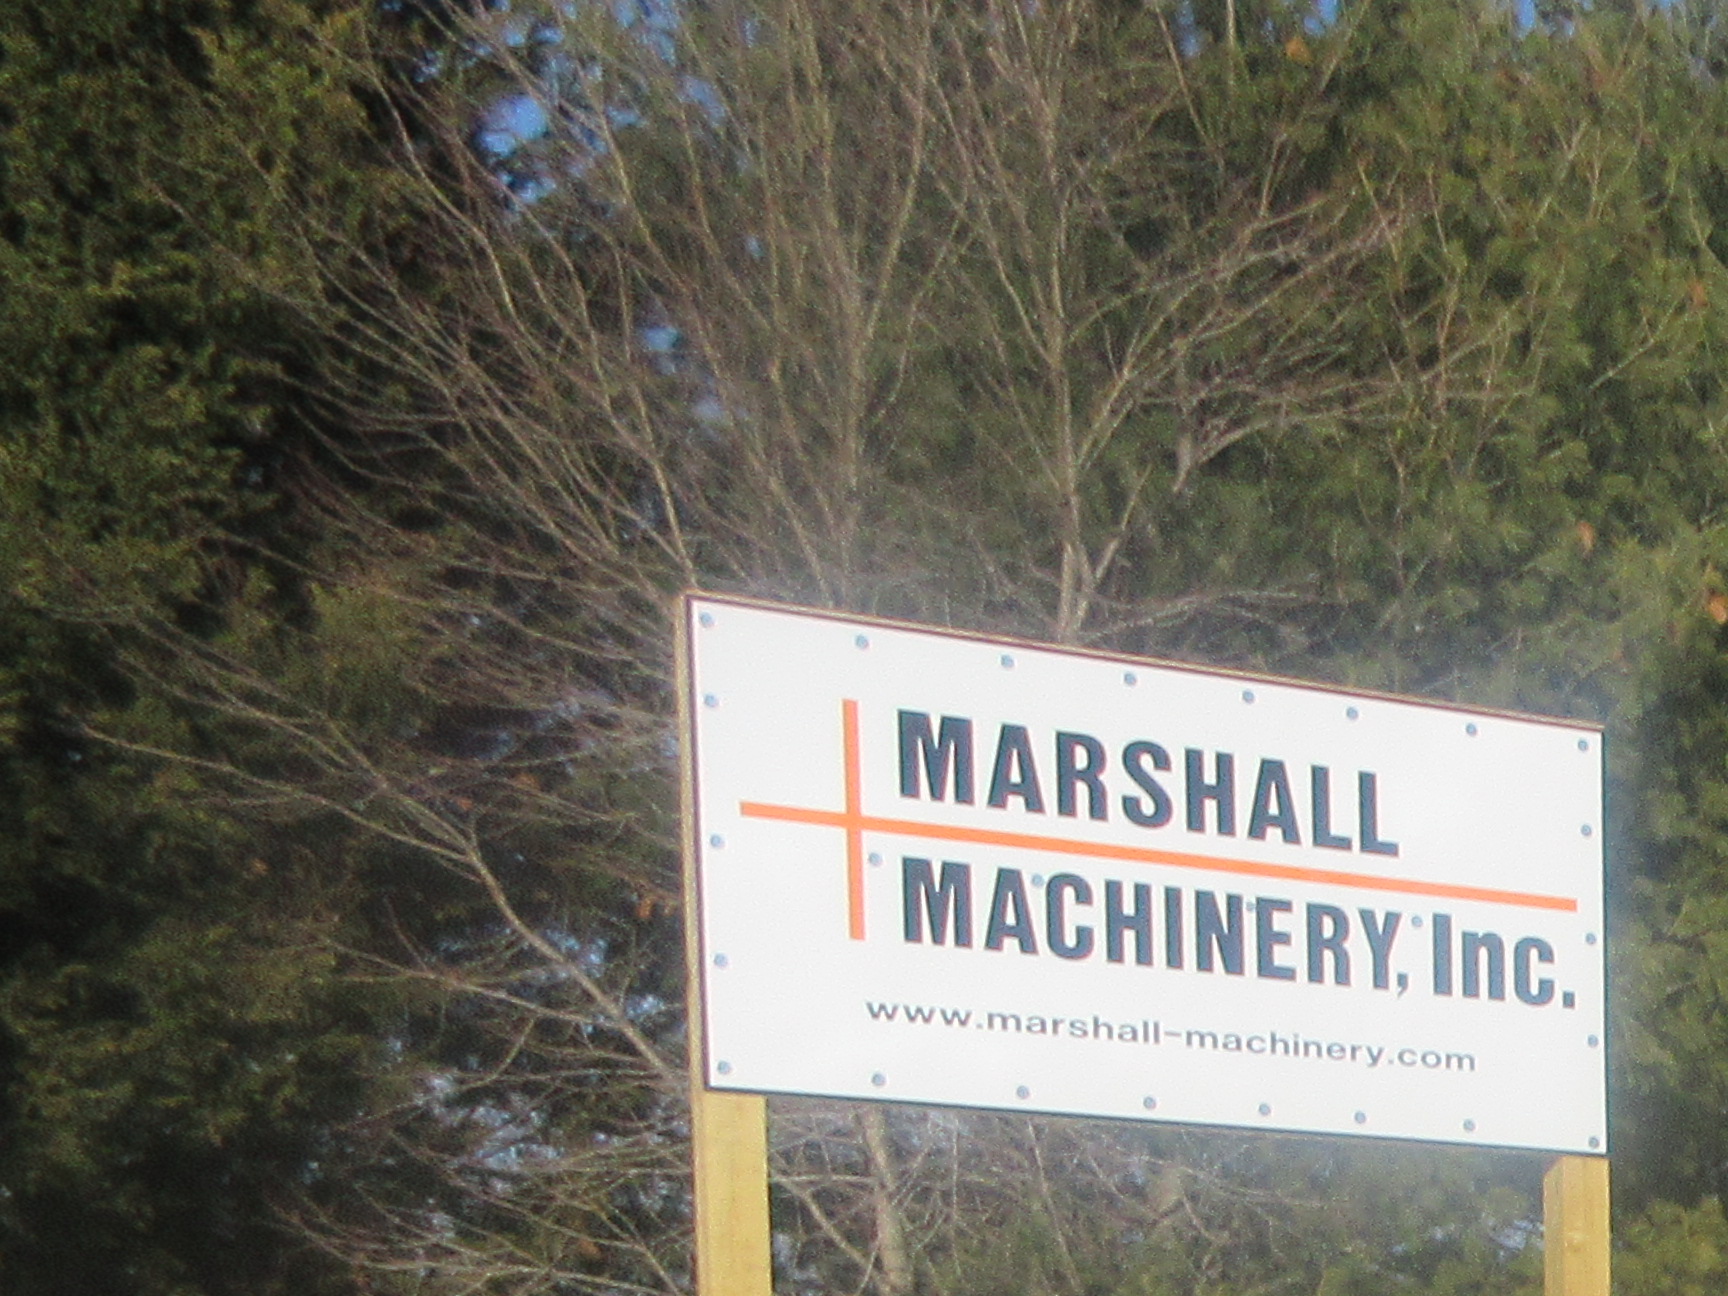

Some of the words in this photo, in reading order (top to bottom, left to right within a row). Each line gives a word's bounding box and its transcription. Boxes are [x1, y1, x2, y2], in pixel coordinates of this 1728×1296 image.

[896, 708, 1401, 858] MARSHALL
[901, 856, 1409, 996] MACHINERY,
[1431, 913, 1577, 1010] Inc.
[866, 998, 1477, 1073] www.marshall-machinery.com
